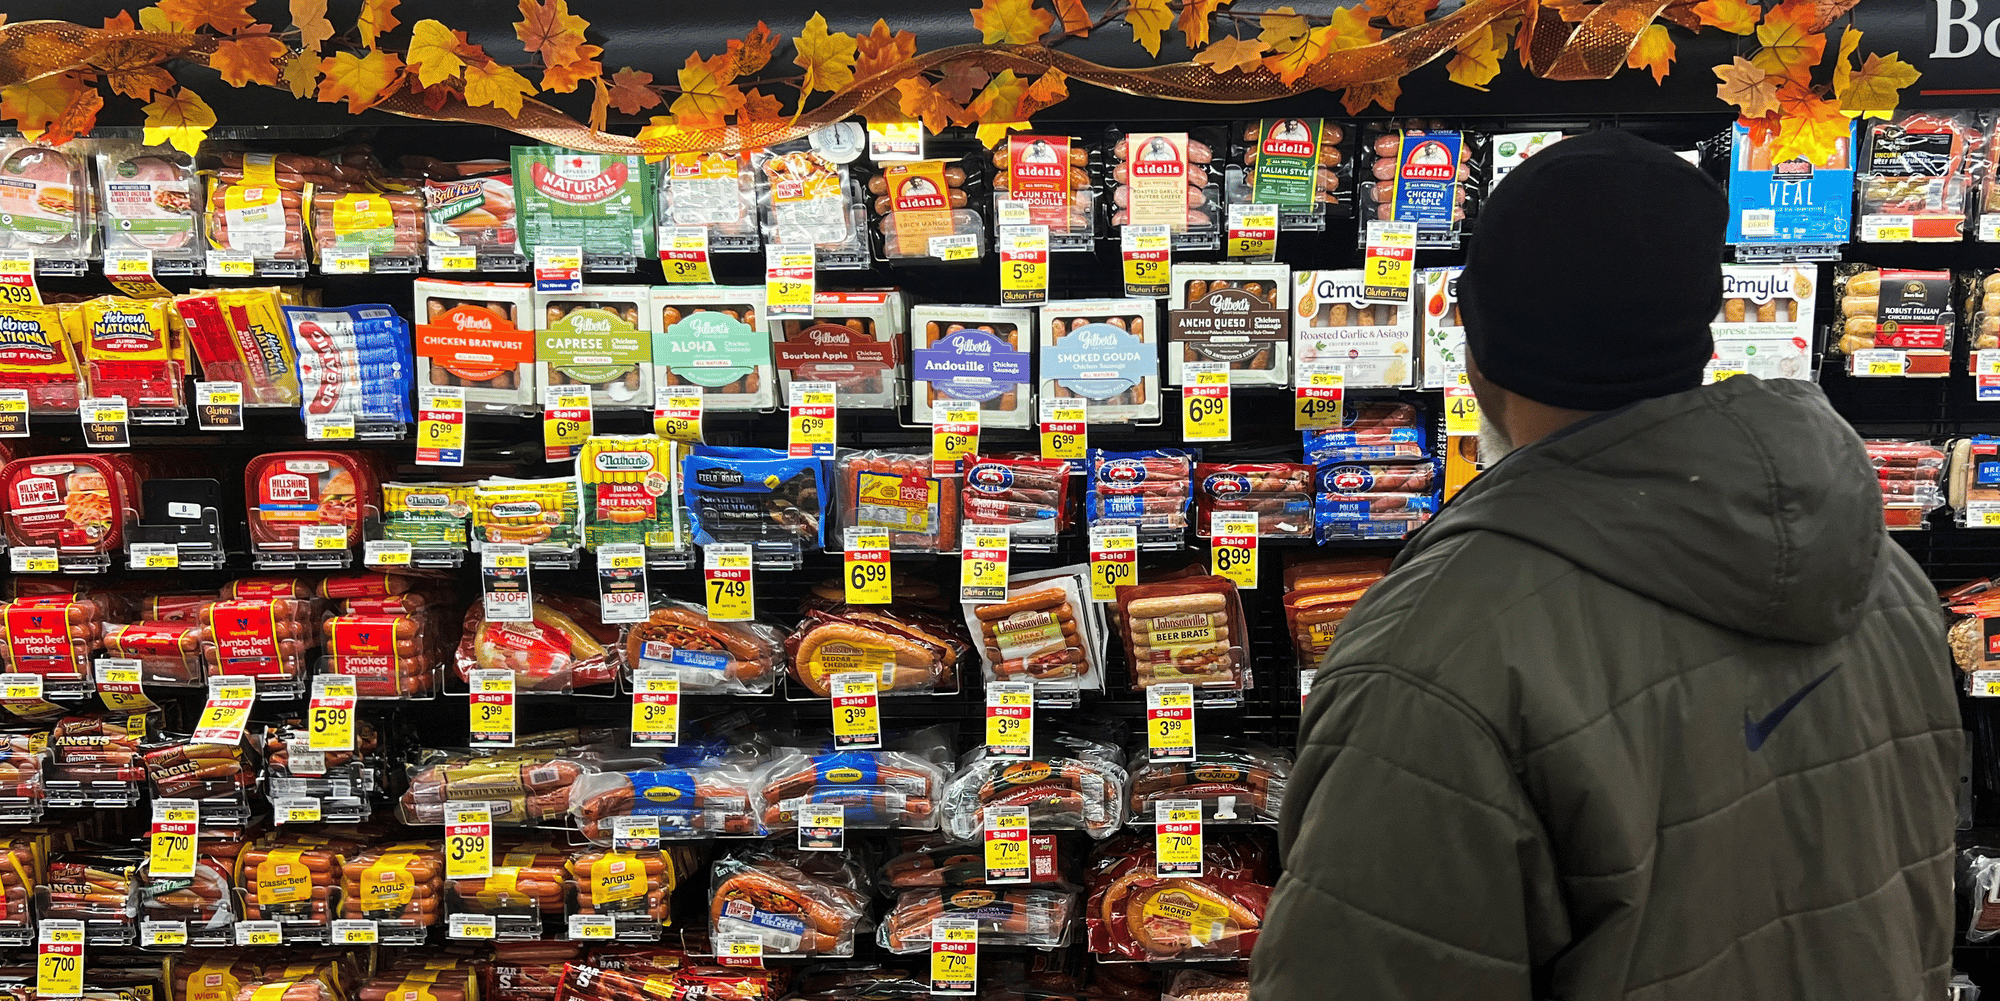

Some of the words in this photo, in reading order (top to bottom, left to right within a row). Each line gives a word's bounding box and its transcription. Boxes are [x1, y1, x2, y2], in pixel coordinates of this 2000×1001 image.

[1266, 143, 1310, 155] aidells
[1017, 166, 1061, 177] aidells
[1136, 165, 1181, 175] aidells
[1259, 166, 1286, 175] ITALIAN
[1290, 168, 1312, 177] STYLE
[1406, 166, 1450, 177] aidells
[544, 176, 617, 199] NATURAL
[542, 186, 572, 201] UNCURED
[571, 193, 593, 201] TURKEY
[594, 191, 606, 199] HOT
[606, 185, 618, 196] DOG
[1013, 190, 1037, 199] CAJUN
[1039, 191, 1067, 200] STYLE
[1407, 190, 1444, 199] CHICKEN
[1769, 181, 1814, 206] VEAL
[900, 197, 943, 209] aidells
[1408, 198, 1415, 206] &
[242, 207, 267, 215] Natural
[434, 203, 462, 222] TURKEY
[669, 251, 698, 260] Sale!
[1010, 252, 1038, 260] Sale!
[1133, 252, 1160, 260] Sale!
[1375, 248, 1405, 256] Sale!
[1127, 285, 1149, 294] Gluten
[1151, 286, 1168, 294] Free
[1365, 287, 1387, 297] Gluten
[1389, 289, 1408, 298] Free
[1003, 291, 1025, 300] Gluten
[1027, 291, 1045, 300] Free
[1885, 306, 1910, 316] ROBUST
[1912, 307, 1940, 316] ITALIAN
[104, 311, 145, 326] Hebrew
[1179, 318, 1212, 328] ANCHO
[1214, 317, 1246, 328] QUESO
[94, 323, 153, 337] NATIONAL
[1300, 331, 1338, 341] Roasted
[1341, 330, 1367, 340] Garlic
[1369, 331, 1376, 340] &
[1377, 330, 1409, 342] Asiago
[424, 335, 466, 347] CHICKEN
[468, 337, 523, 351] BRATWURST
[546, 338, 604, 349] CAPRESE
[611, 338, 636, 346] Chicken
[671, 340, 717, 353] ALOHA
[782, 350, 820, 360] Bourbon
[822, 351, 849, 362] Apple
[1058, 353, 1100, 363] SMOKED
[1103, 351, 1141, 362] GOUDA
[925, 360, 985, 372] Andouille
[1306, 389, 1334, 398] Sale!
[206, 406, 233, 417] Gluten
[427, 412, 455, 420] Sale!
[553, 411, 582, 419] Sale!
[799, 408, 827, 416] Sale!
[211, 416, 229, 424] Free
[91, 424, 118, 434] Gluten
[943, 423, 971, 432] Sale!
[1049, 423, 1077, 432] Sale!
[97, 433, 115, 442] Free
[698, 473, 719, 482] FIELD
[721, 473, 743, 483] ROAST
[19, 481, 56, 494] HILLSHIRE
[271, 478, 309, 489] HILLSHIRE
[648, 480, 663, 490] BEEF
[271, 488, 292, 497] FARM
[613, 485, 638, 493] JUMBO
[21, 493, 40, 502] FARM
[601, 498, 620, 506] BEEF
[621, 498, 653, 507] FRANKS
[1113, 495, 1134, 504] JUMBO
[1112, 502, 1137, 513] FRANKS
[1339, 503, 1359, 513] POLISH
[23, 514, 42, 523] SMOKED
[43, 513, 60, 521] HAM
[1220, 537, 1248, 545] Sale!
[854, 552, 882, 561] Sale!
[971, 550, 999, 559] Sale!
[1099, 552, 1127, 560] Sale!
[714, 570, 742, 579] Sale!
[508, 592, 527, 602] OFF
[624, 593, 644, 603] OFF
[963, 589, 984, 598] Gluten
[987, 589, 1004, 598] Free
[1000, 614, 1051, 633] Johnsonville
[1156, 615, 1206, 631] Johnsonville
[14, 636, 39, 646] Jumbo
[41, 635, 65, 645] Beef
[505, 632, 534, 646] POLISH
[1156, 632, 1183, 642] BEER
[1184, 629, 1210, 641] BRATS
[220, 637, 245, 648] Jumbo
[248, 636, 271, 646] Beef
[26, 645, 57, 655] Franks
[233, 647, 263, 656] Franks
[345, 656, 388, 666] Smoked
[676, 650, 693, 659] BEEF
[694, 653, 725, 663] SMOKED
[684, 658, 717, 667] SAUSAGE
[346, 665, 388, 676] Sausage
[478, 695, 505, 703] Sale!
[642, 694, 669, 702] Sale!
[841, 697, 868, 706] Sale!
[995, 707, 1023, 716] Sale!
[1156, 709, 1183, 718] Sale!
[56, 736, 111, 747] ANGUS
[66, 754, 97, 763] ORIGINAL
[828, 771, 861, 779] BUTTERBALL
[646, 790, 678, 799] BUTTERBALL
[160, 824, 188, 832] Sale!
[454, 826, 481, 834] Sale!
[993, 830, 1020, 839] Sale!
[1032, 837, 1050, 845] Feed
[1040, 844, 1053, 852] Joy
[259, 879, 287, 888] Classic
[288, 876, 307, 886] Beef
[602, 872, 635, 886] Angus
[371, 883, 405, 895] Angus
[1159, 905, 1192, 917] SMOKED
[756, 911, 776, 920] BEEF
[776, 914, 804, 929] POLSKA
[761, 919, 797, 932] KIELBASA
[497, 966, 517, 975] BAR
[578, 964, 601, 979] BAR
[499, 974, 512, 990] S
[576, 973, 593, 989] S
[137, 987, 151, 996] NO
